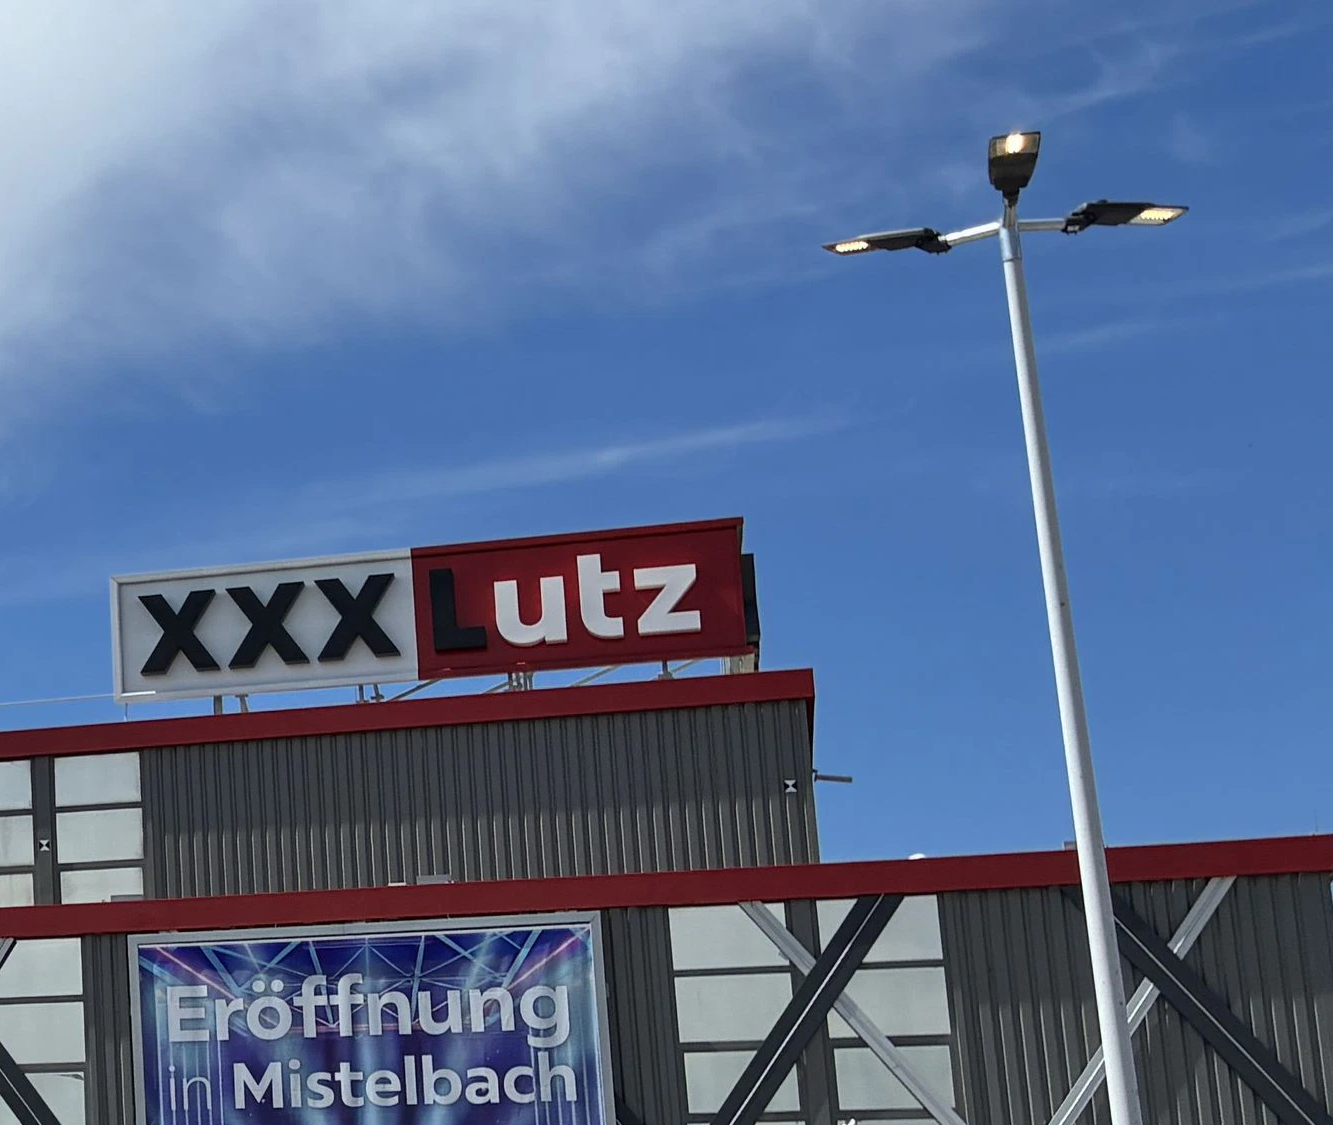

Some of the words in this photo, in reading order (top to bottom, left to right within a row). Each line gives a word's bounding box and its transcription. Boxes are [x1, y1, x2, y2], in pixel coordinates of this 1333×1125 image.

[137, 553, 702, 677] XXXLutz
[165, 972, 571, 1049] Eröffnung
[168, 1064, 212, 1111] in
[233, 1051, 578, 1110] Mistelbach
